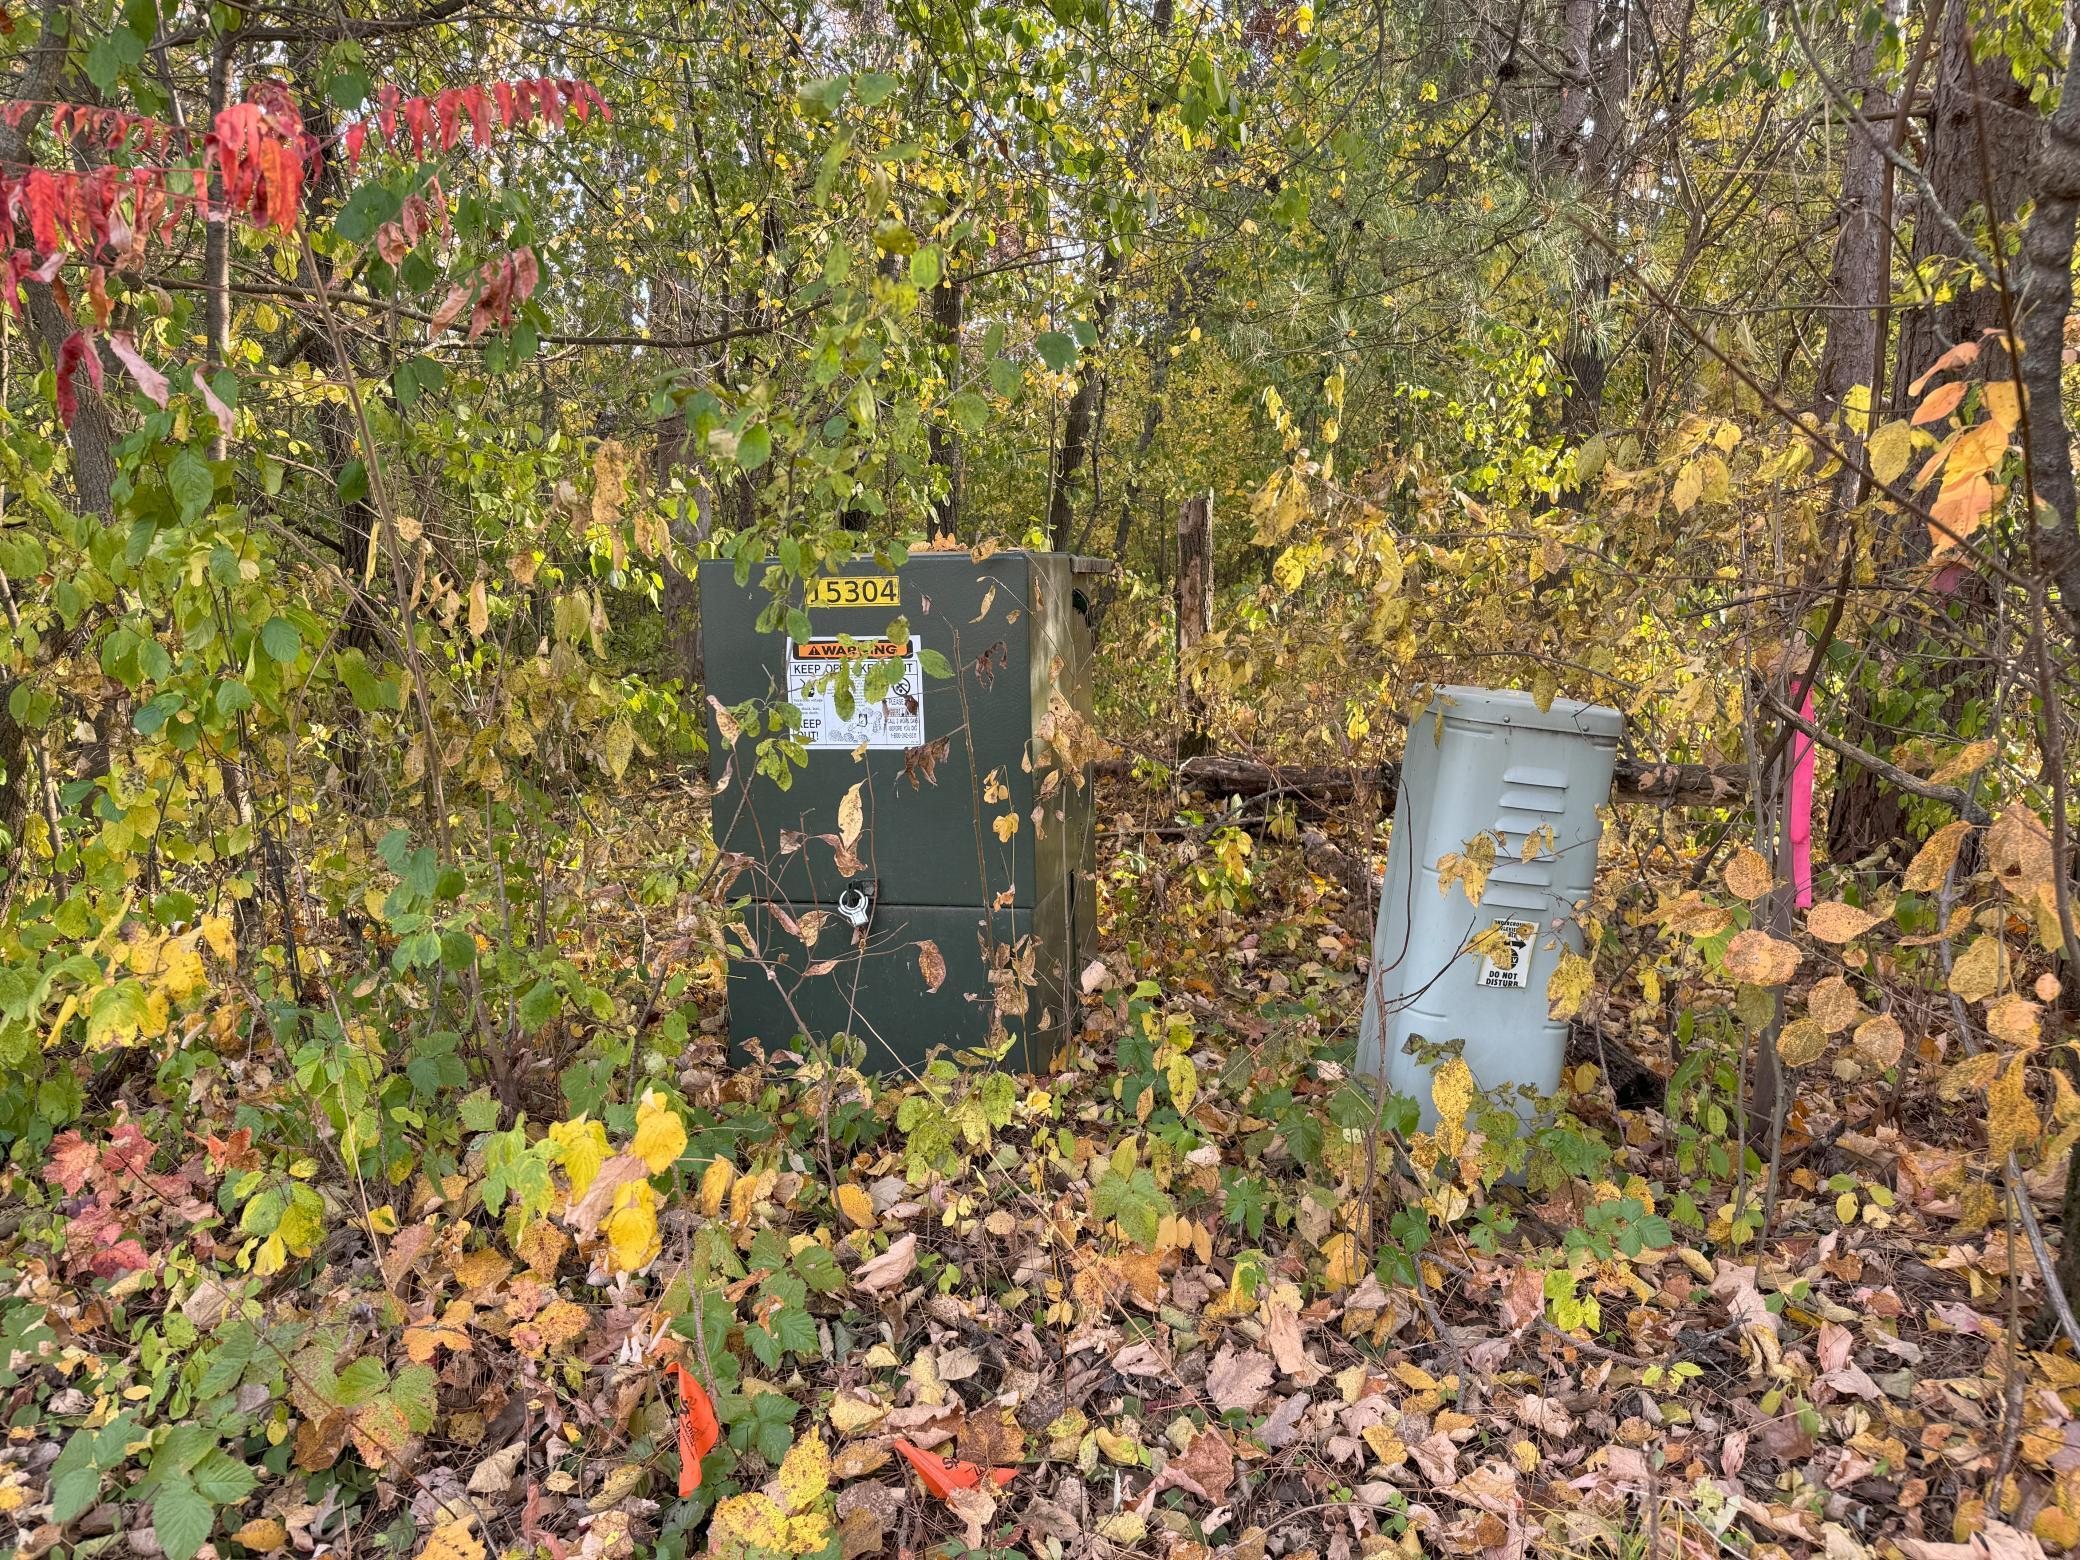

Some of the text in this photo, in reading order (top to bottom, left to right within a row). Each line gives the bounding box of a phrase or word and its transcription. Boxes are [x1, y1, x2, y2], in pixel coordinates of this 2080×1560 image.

[822, 645, 897, 655] WARNG
[794, 664, 820, 674] KEEP
[801, 719, 821, 729] EEP
[1489, 970, 1518, 980] DO NOT
